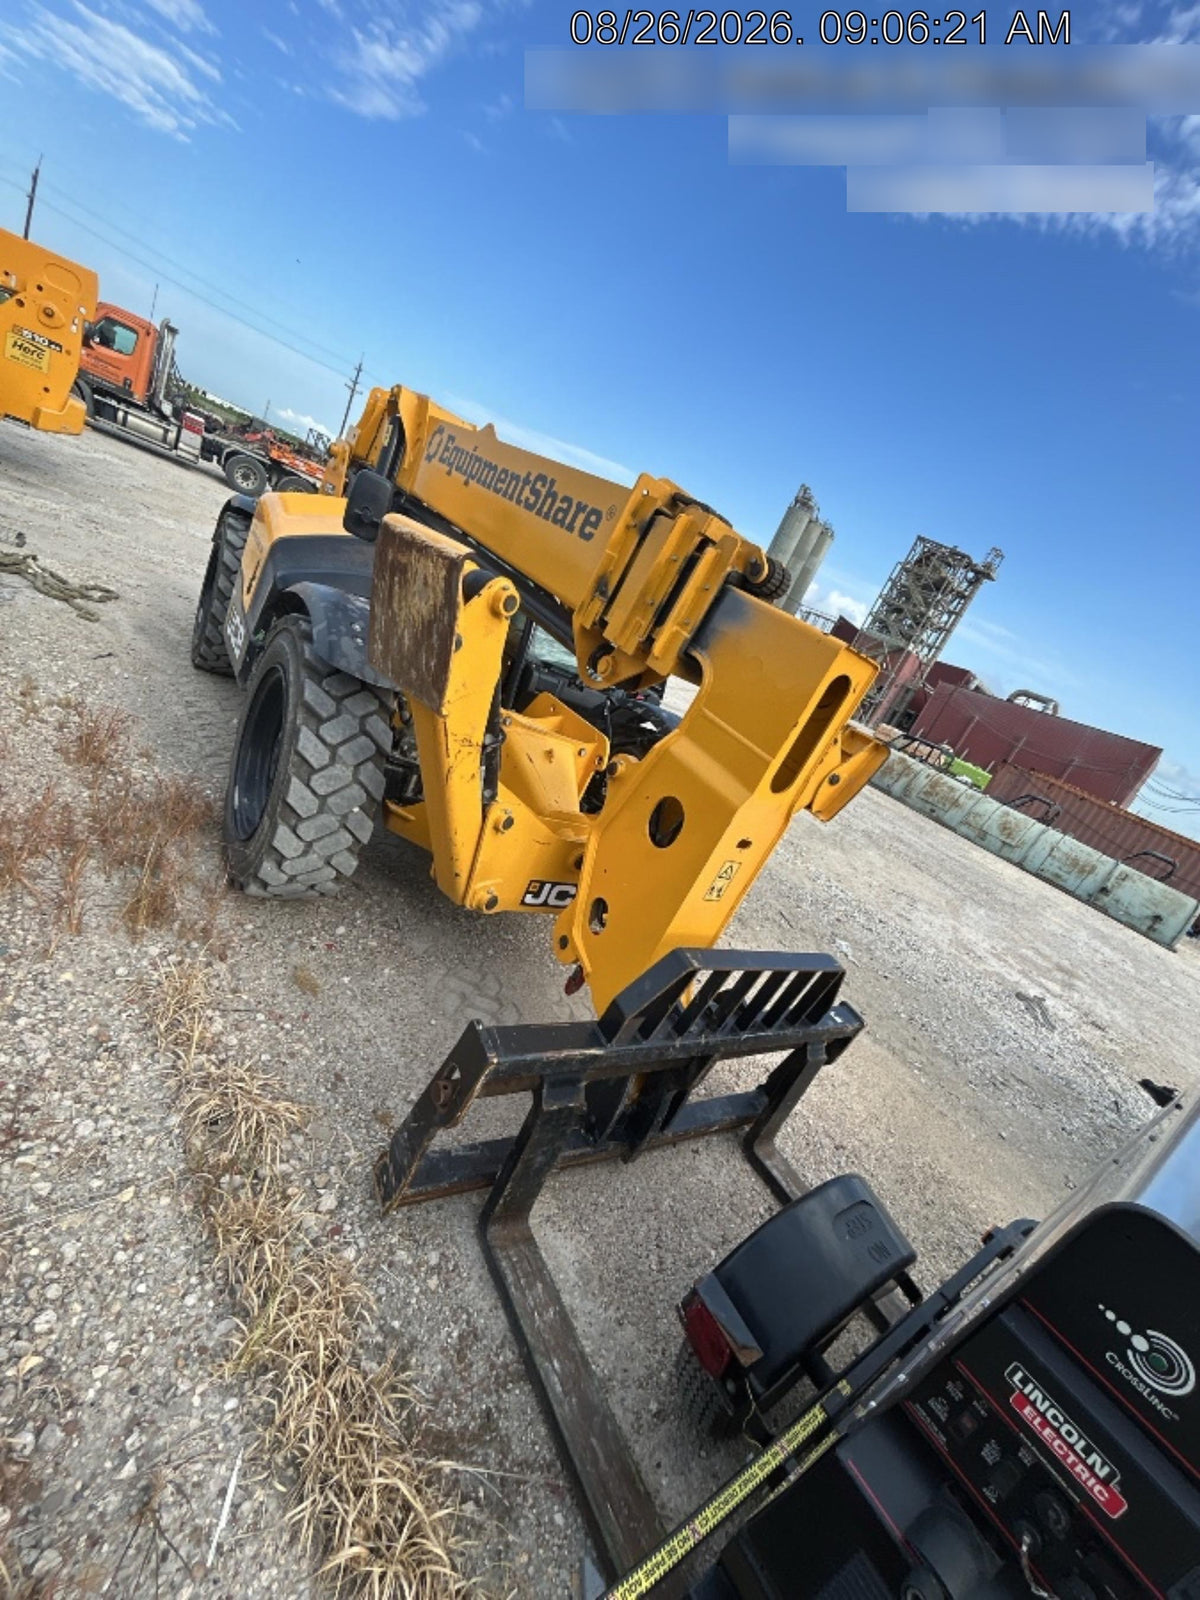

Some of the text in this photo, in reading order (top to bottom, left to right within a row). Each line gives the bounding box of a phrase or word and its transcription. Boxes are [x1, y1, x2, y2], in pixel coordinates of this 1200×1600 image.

[439, 433, 603, 542] EquipmentShare
[523, 883, 577, 906] JC
[1013, 1370, 1110, 1479] LINCOLN
[1022, 1405, 1110, 1502] ELECTRIC
